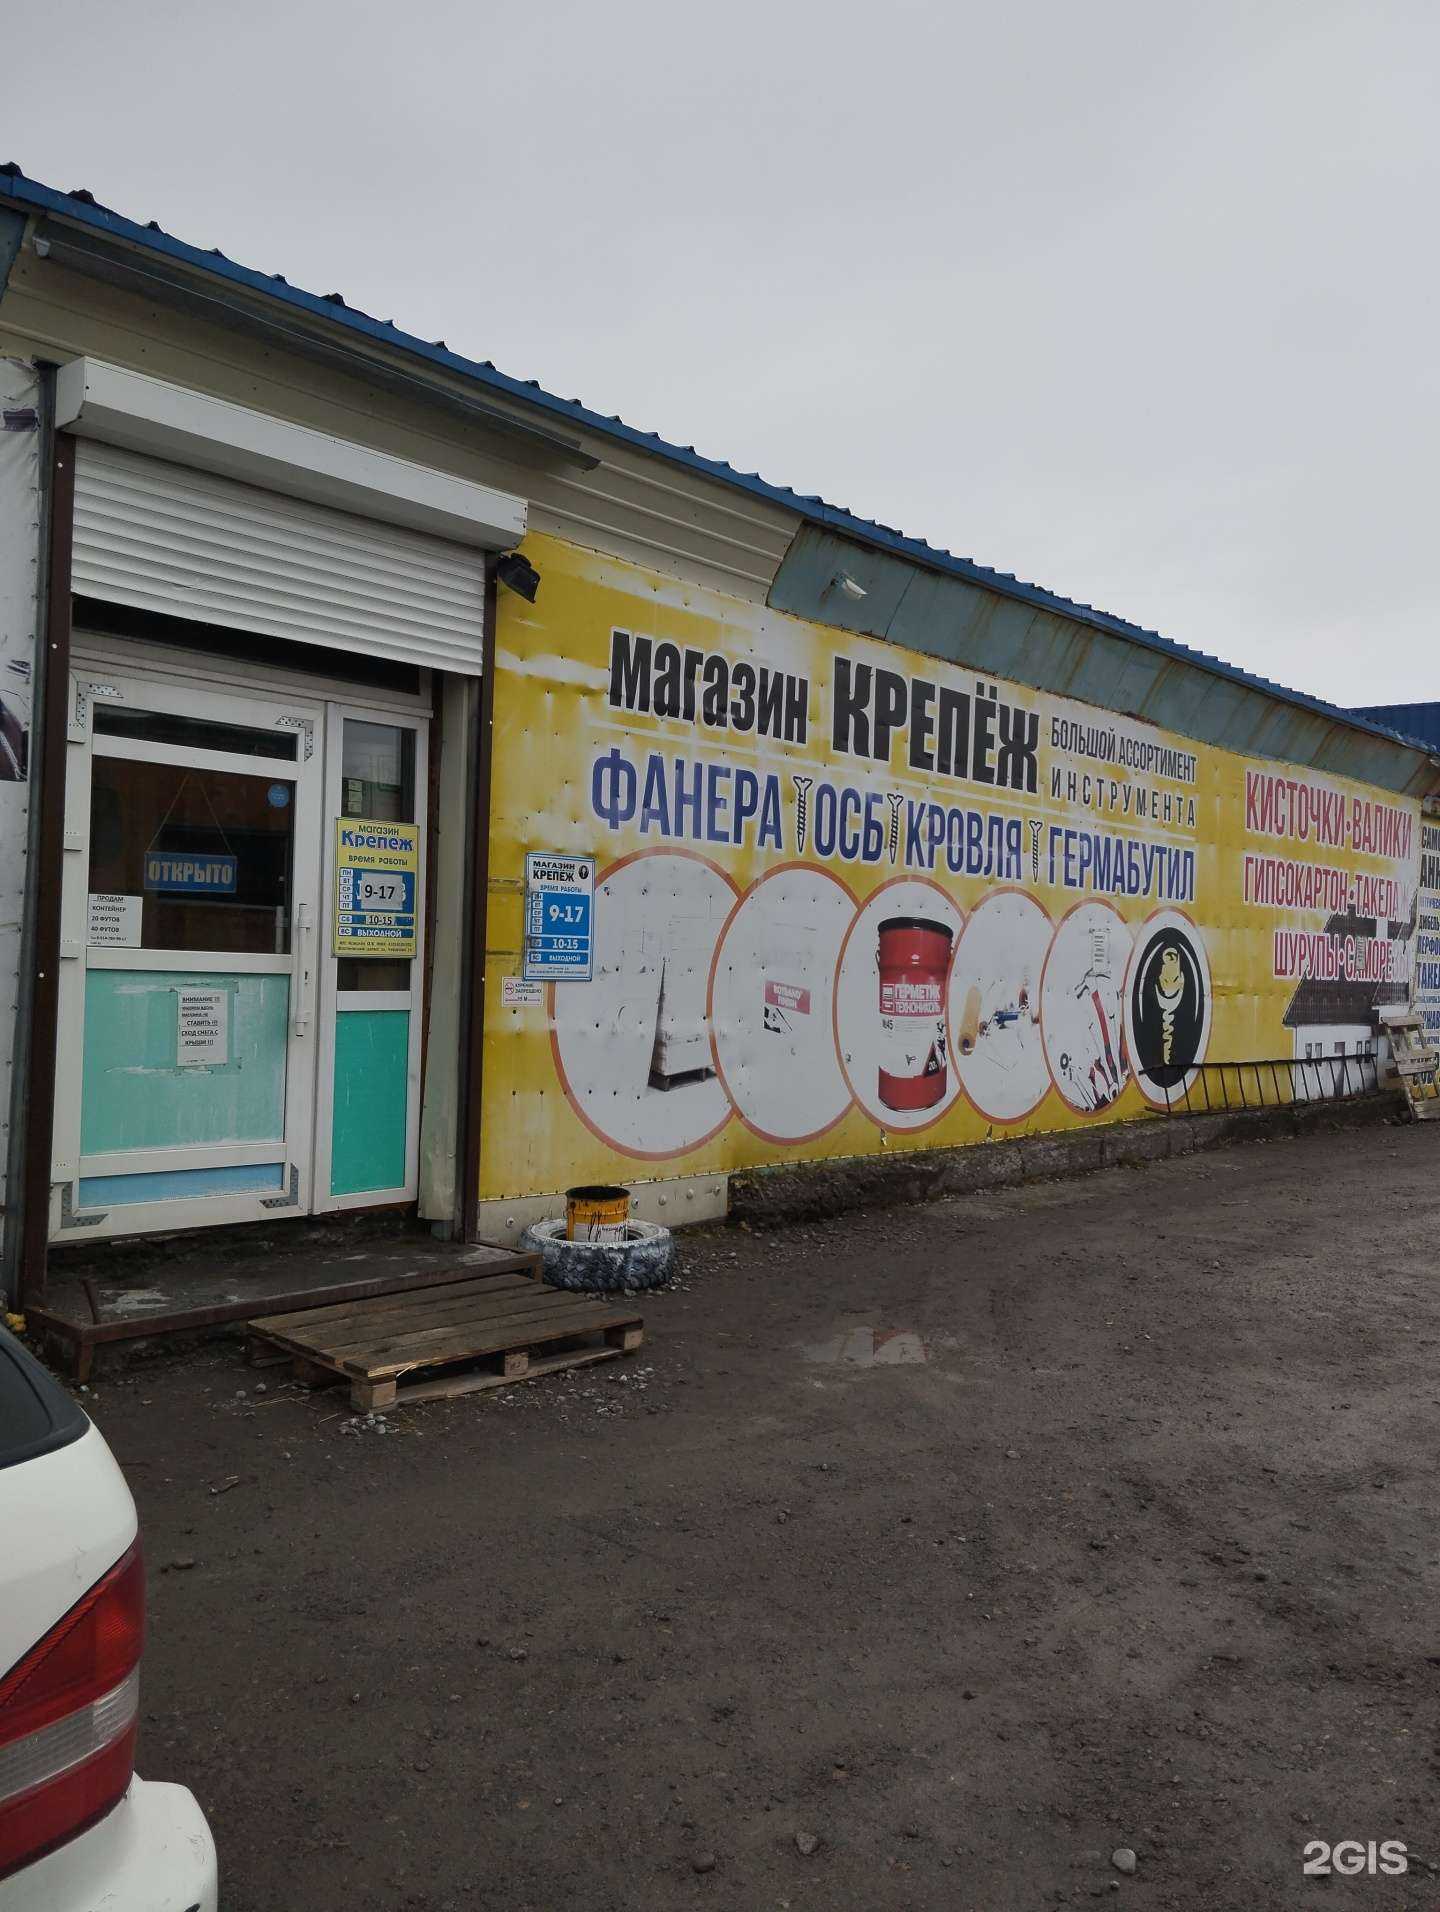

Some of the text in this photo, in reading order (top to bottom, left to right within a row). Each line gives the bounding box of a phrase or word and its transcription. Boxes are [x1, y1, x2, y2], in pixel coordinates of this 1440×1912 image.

[833, 656, 1040, 794] КРЕПЁЖ
[1052, 717, 1197, 783] БОЛЬШОЙ АССОРТИМЕНТ
[1051, 767, 1195, 827] ИНСТРУМЕНТА
[592, 748, 1195, 901] ФАНЕРА ОСБ КРОВЛЯ ГЕРМАБУТИЛ
[1246, 772, 1412, 859] КИСТОЧКИ ВАЛИКИ
[149, 861, 233, 884] ОТКРЫТО
[533, 860, 576, 870] МАГАЗИН
[364, 884, 395, 900] 9-17
[1244, 856, 1410, 922] ГИПСОКАРТОН ТАКЕЛА
[368, 915, 393, 925] 10-15
[549, 905, 584, 923] 9-17
[357, 928, 402, 938] ВЫХОДНОЙ
[552, 939, 579, 949] 10-15
[1275, 932, 1339, 979] ШУРУПЫ
